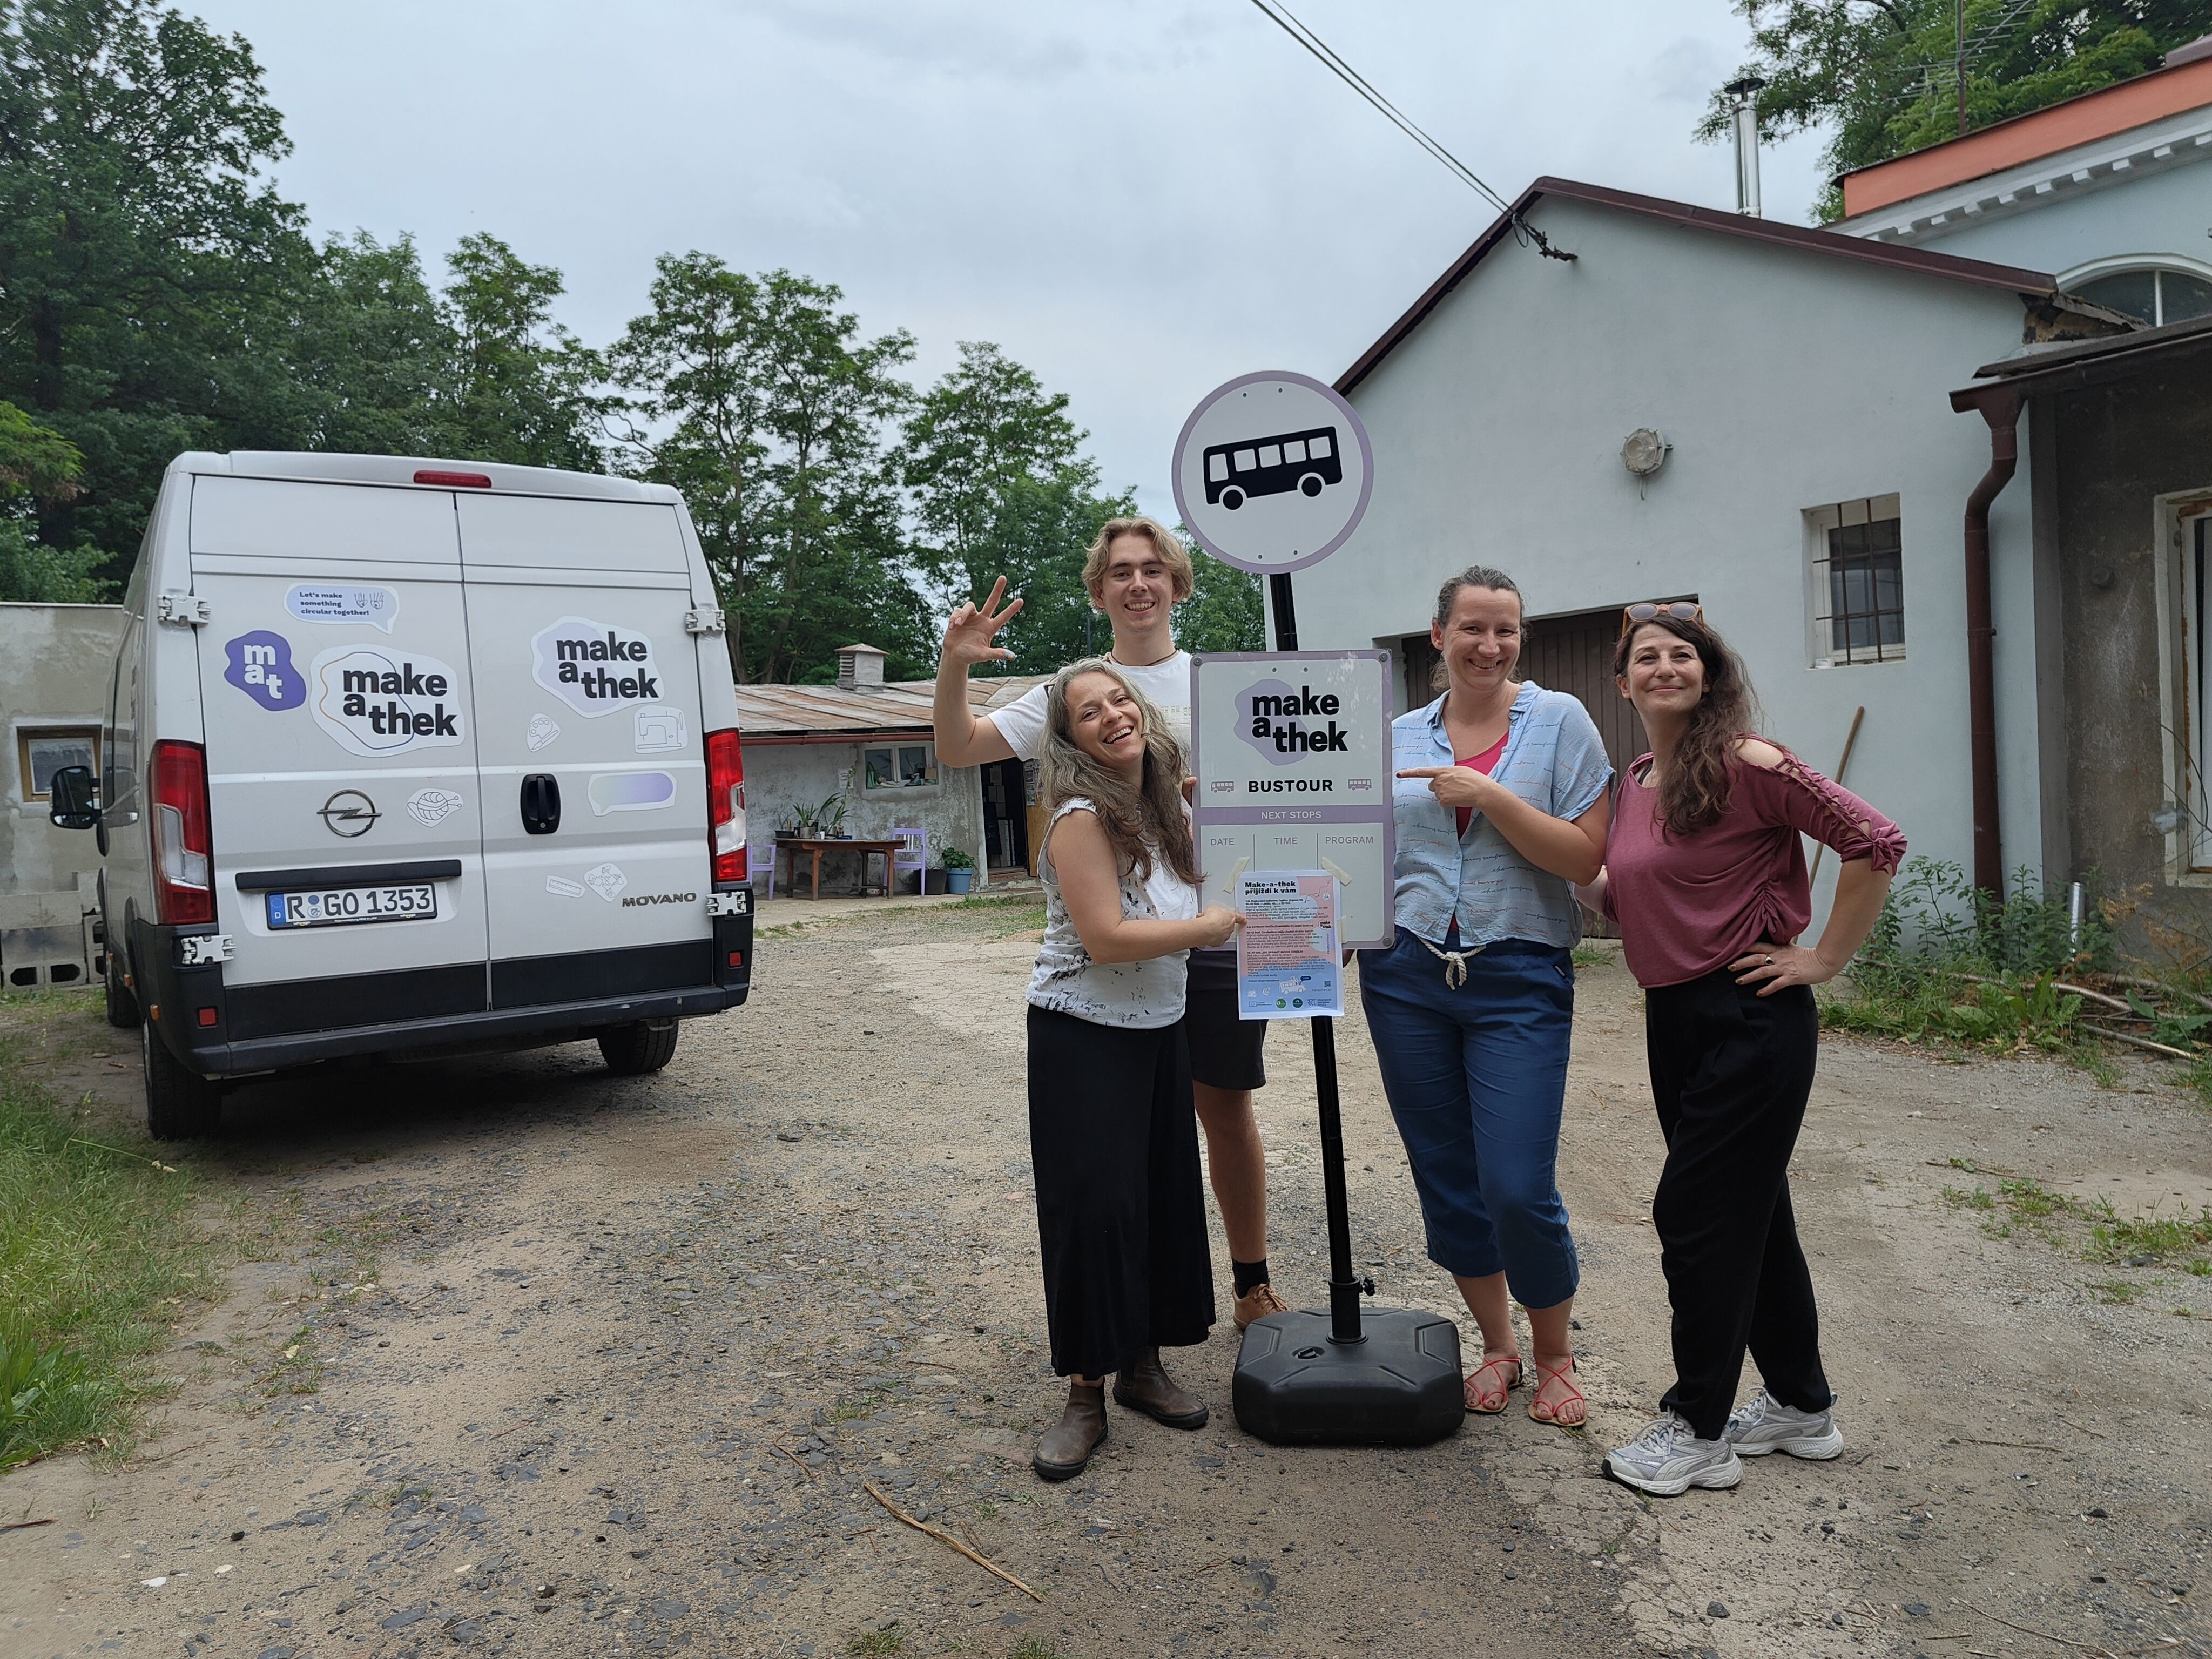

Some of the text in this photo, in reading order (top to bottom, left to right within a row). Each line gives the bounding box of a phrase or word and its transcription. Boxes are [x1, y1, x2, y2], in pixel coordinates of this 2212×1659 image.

[300, 600, 342, 608] something
[334, 609, 369, 617] together!
[556, 631, 647, 662] make
[343, 663, 447, 696] make
[1252, 685, 1339, 716] make
[1248, 779, 1333, 792] BUSTOUR
[1261, 811, 1321, 819] NEXT STOPS
[287, 888, 430, 920] R GO 1353
[622, 892, 697, 907] MOVANO
[274, 911, 281, 919] D
